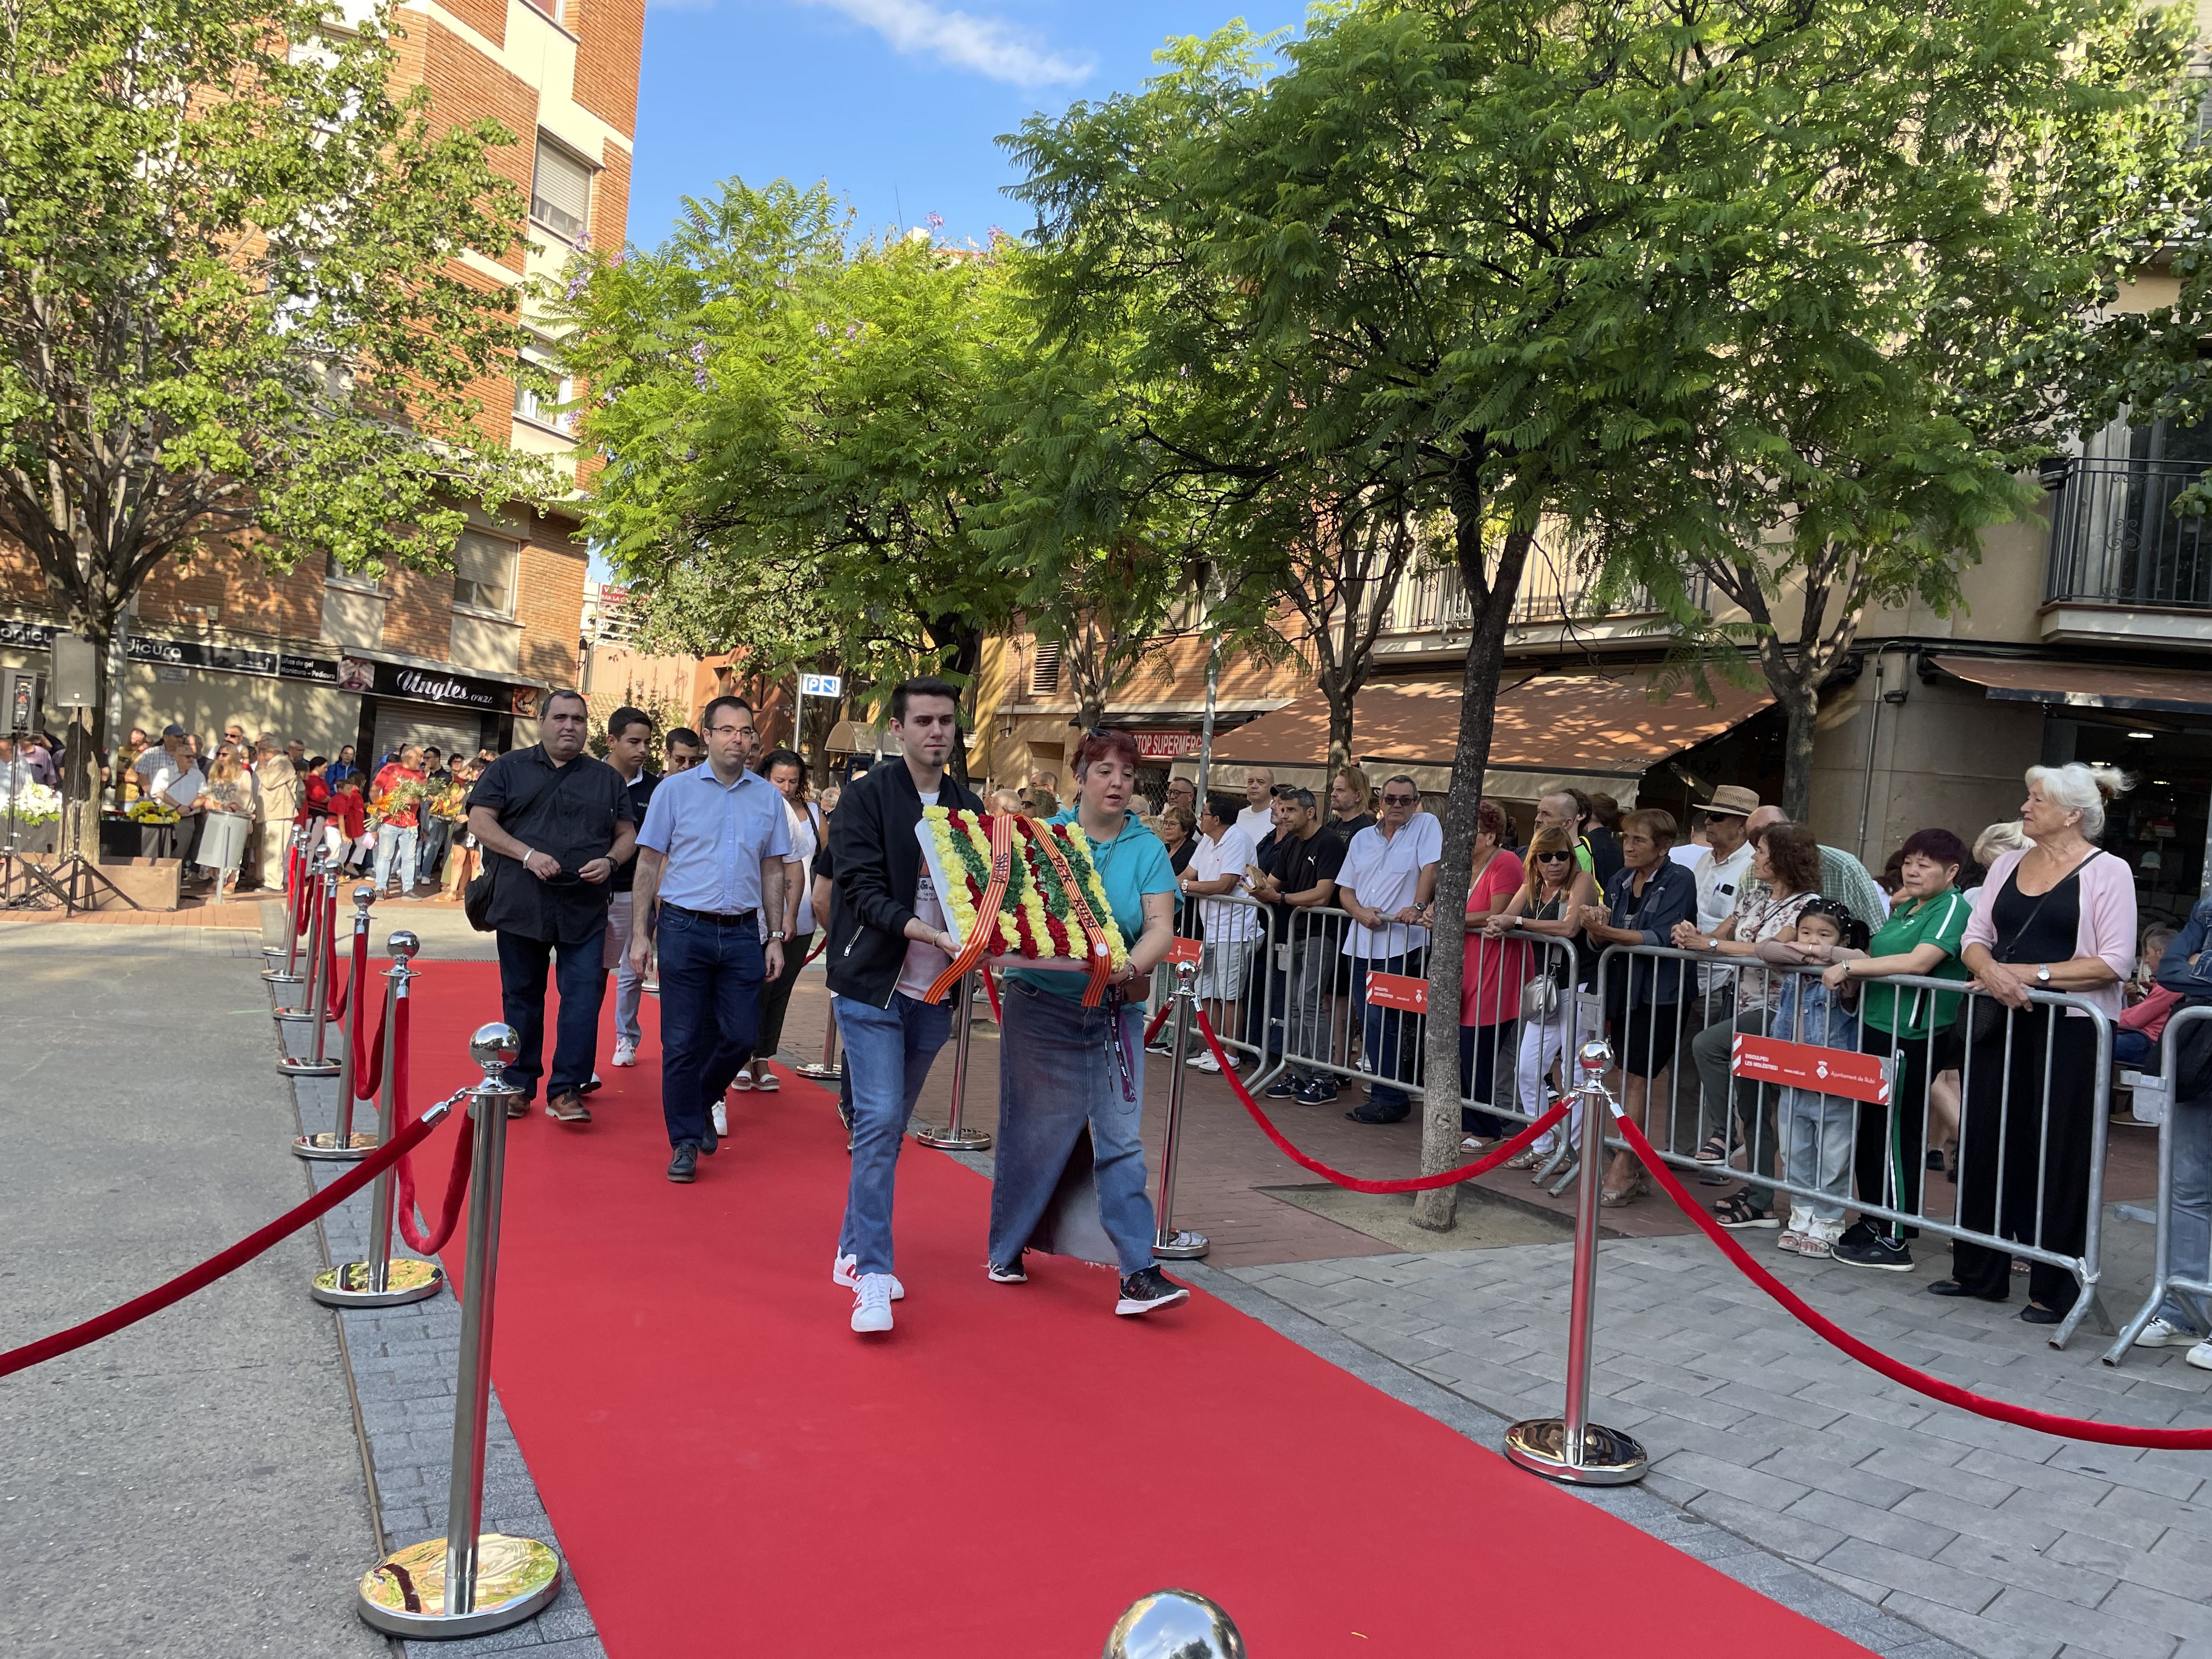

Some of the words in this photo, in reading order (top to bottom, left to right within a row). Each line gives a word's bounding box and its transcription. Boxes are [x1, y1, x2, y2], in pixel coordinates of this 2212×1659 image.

[127, 639, 182, 658] dicura
[304, 661, 314, 669] gel
[397, 669, 469, 701] Ungles
[1052, 855, 1072, 882] PER
[1745, 1053, 1769, 1062] DISCULPEU
[1830, 1070, 1857, 1081] Ajuntament
